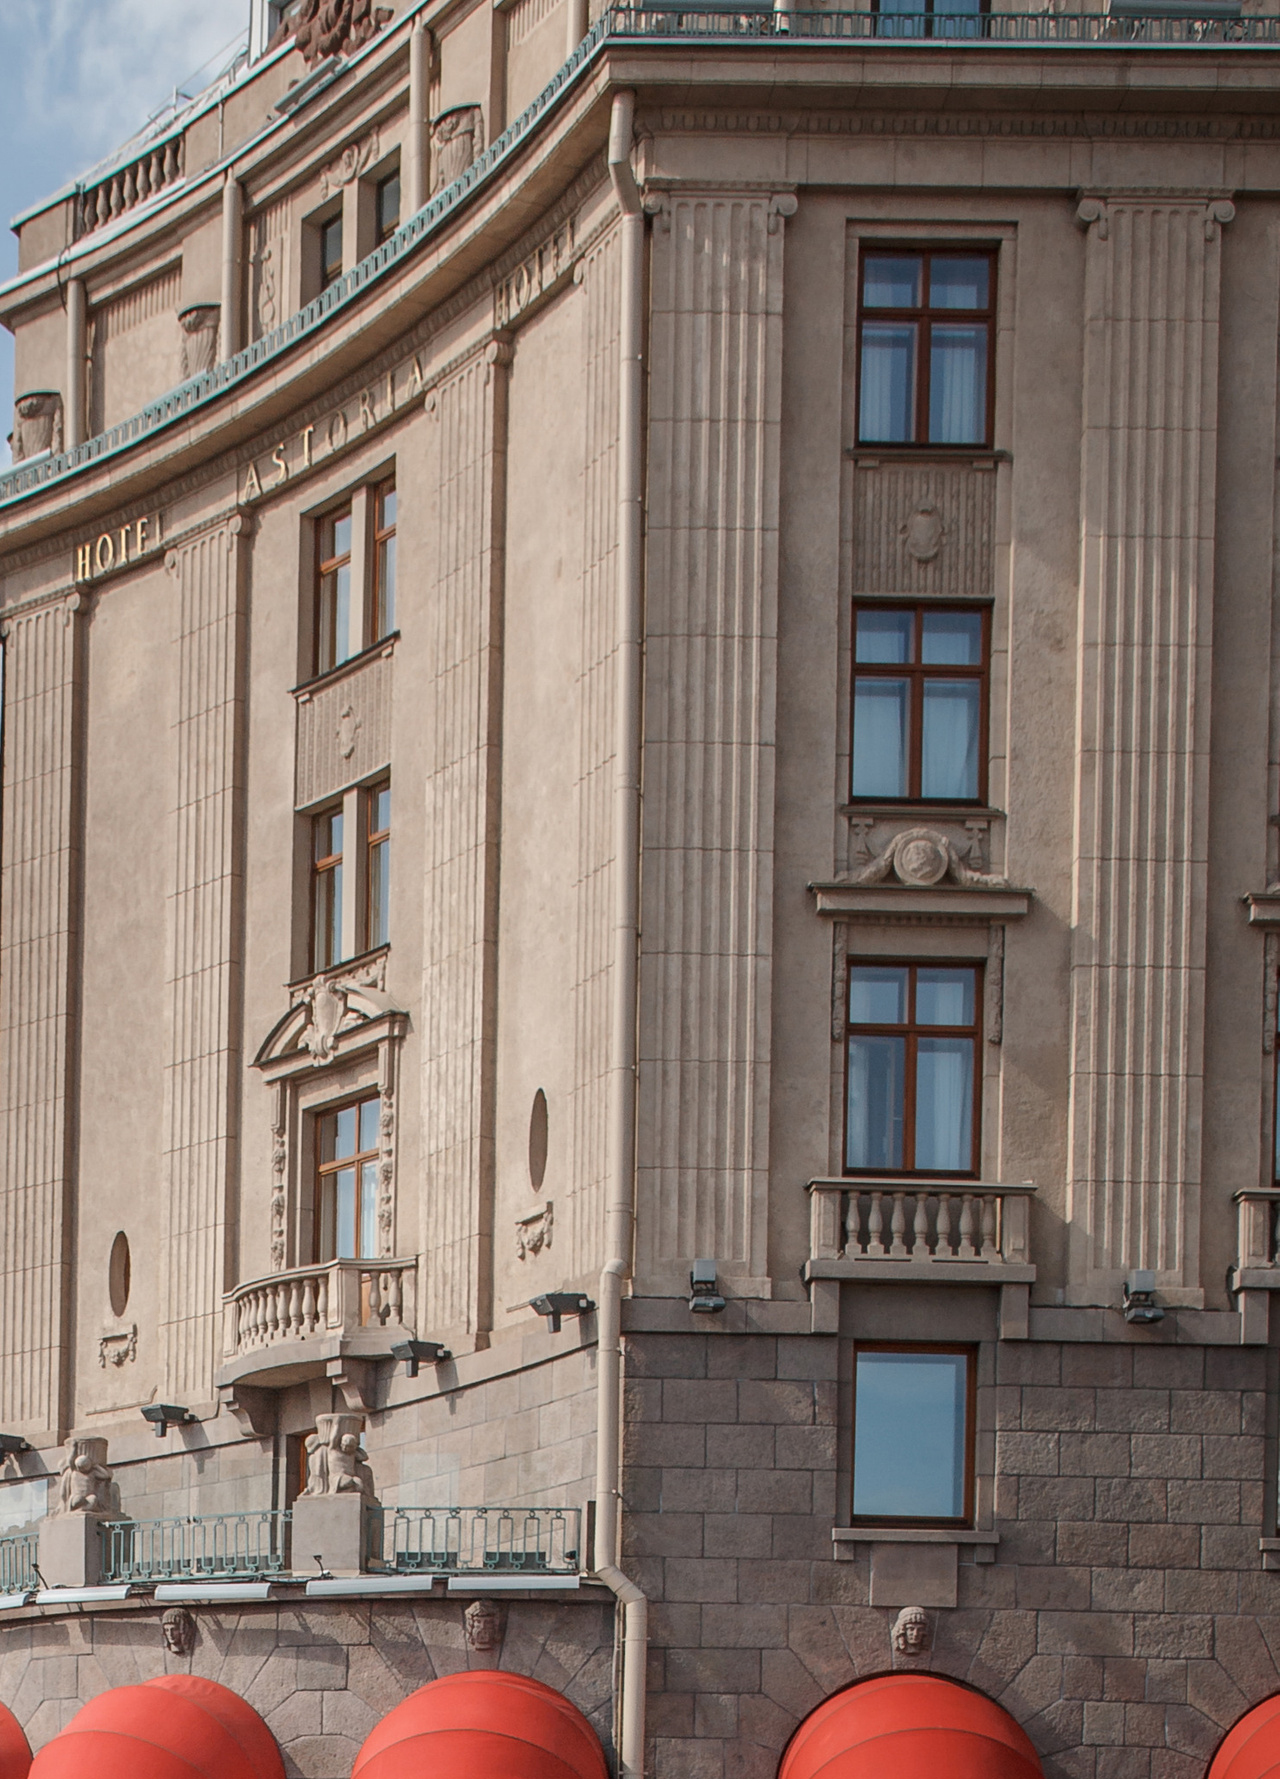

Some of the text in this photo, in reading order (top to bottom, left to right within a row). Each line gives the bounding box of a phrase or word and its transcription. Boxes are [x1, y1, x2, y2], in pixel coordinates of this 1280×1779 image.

[77, 217, 573, 582] HOTEL ASTORIA HOTEL
